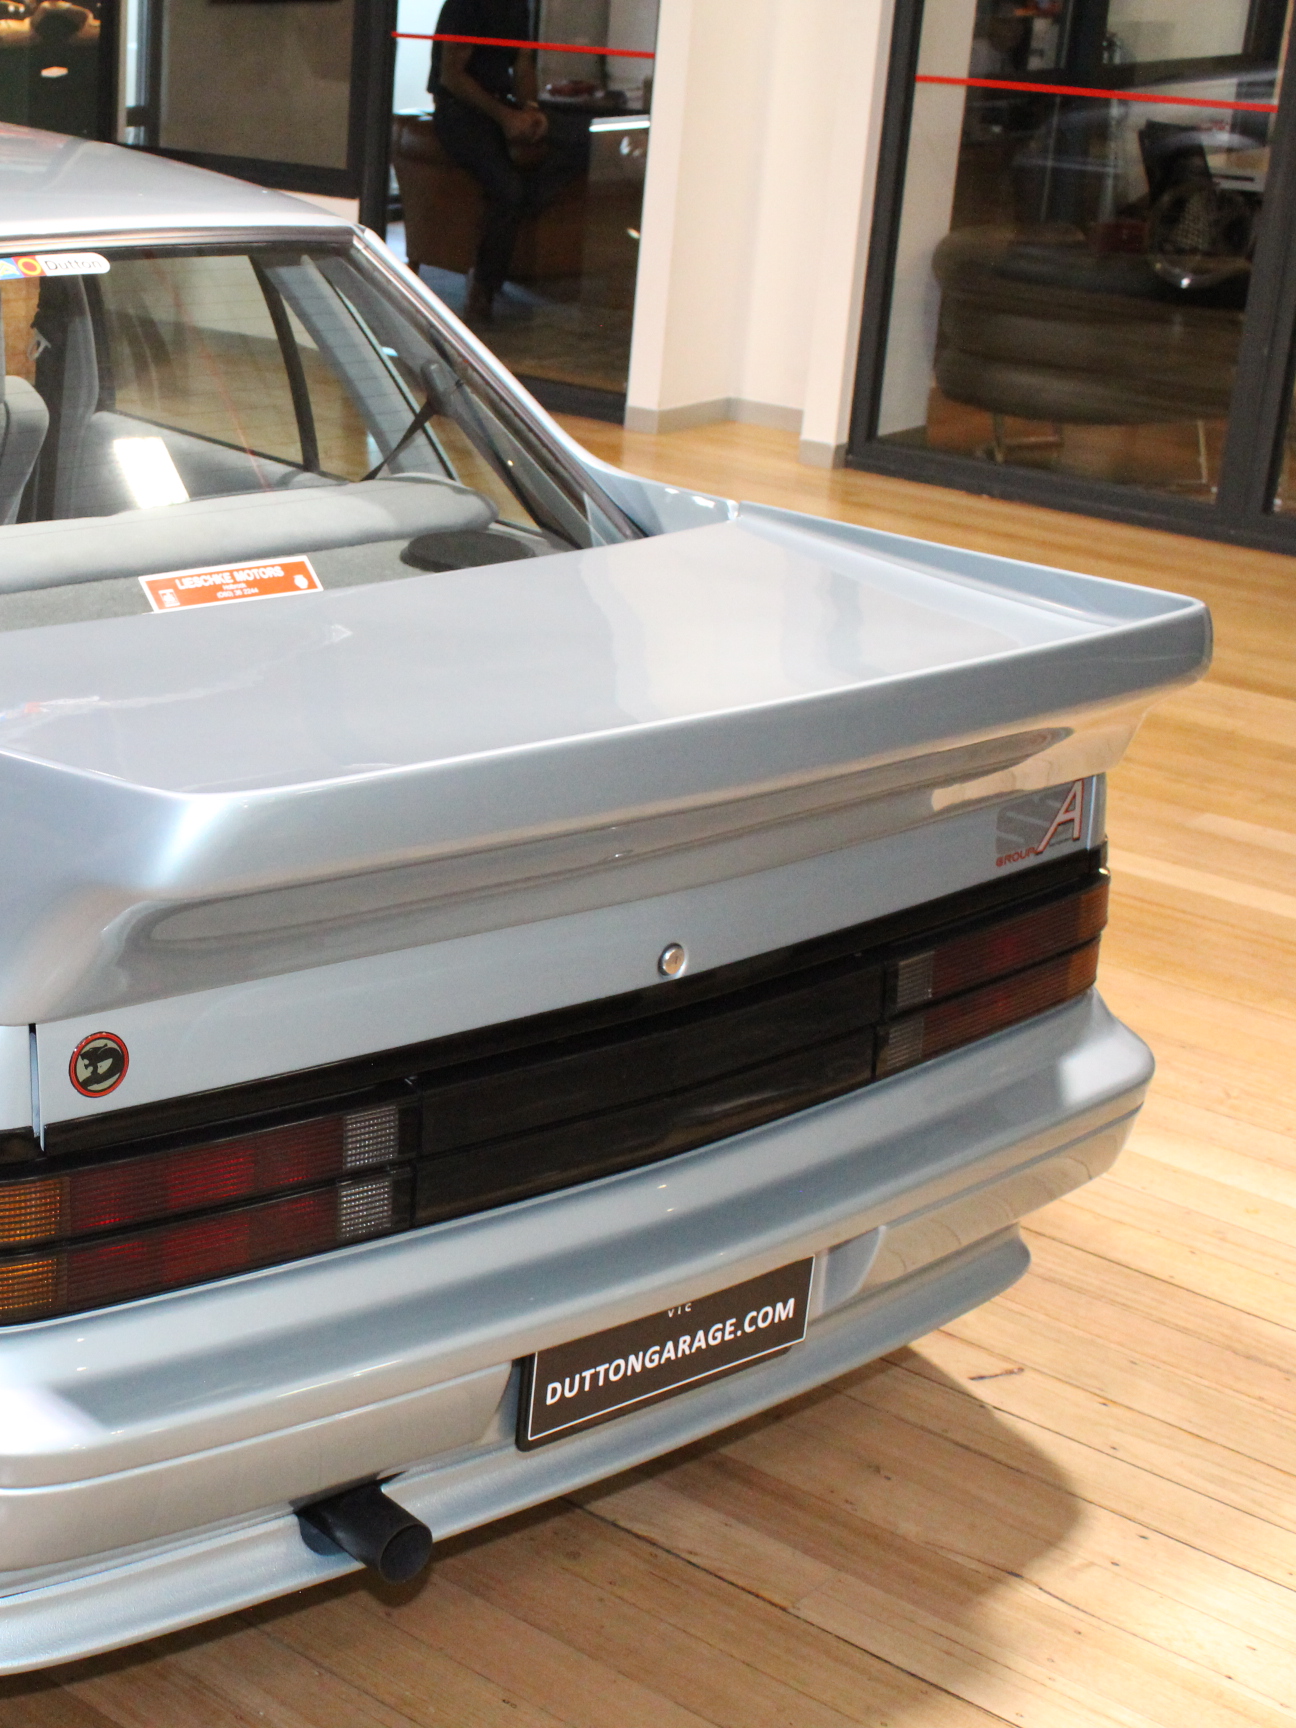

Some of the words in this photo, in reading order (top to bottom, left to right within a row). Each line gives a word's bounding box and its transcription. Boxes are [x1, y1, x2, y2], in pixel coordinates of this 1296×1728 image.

[44, 260, 102, 270] Dutton
[175, 572, 233, 589] LIESCHKE
[233, 566, 284, 582] MOTORS
[995, 846, 1037, 867] GROUP
[1034, 778, 1084, 855] A
[667, 1302, 692, 1318] VIC
[545, 1297, 796, 1406] DUTTONGARAGE.COM
